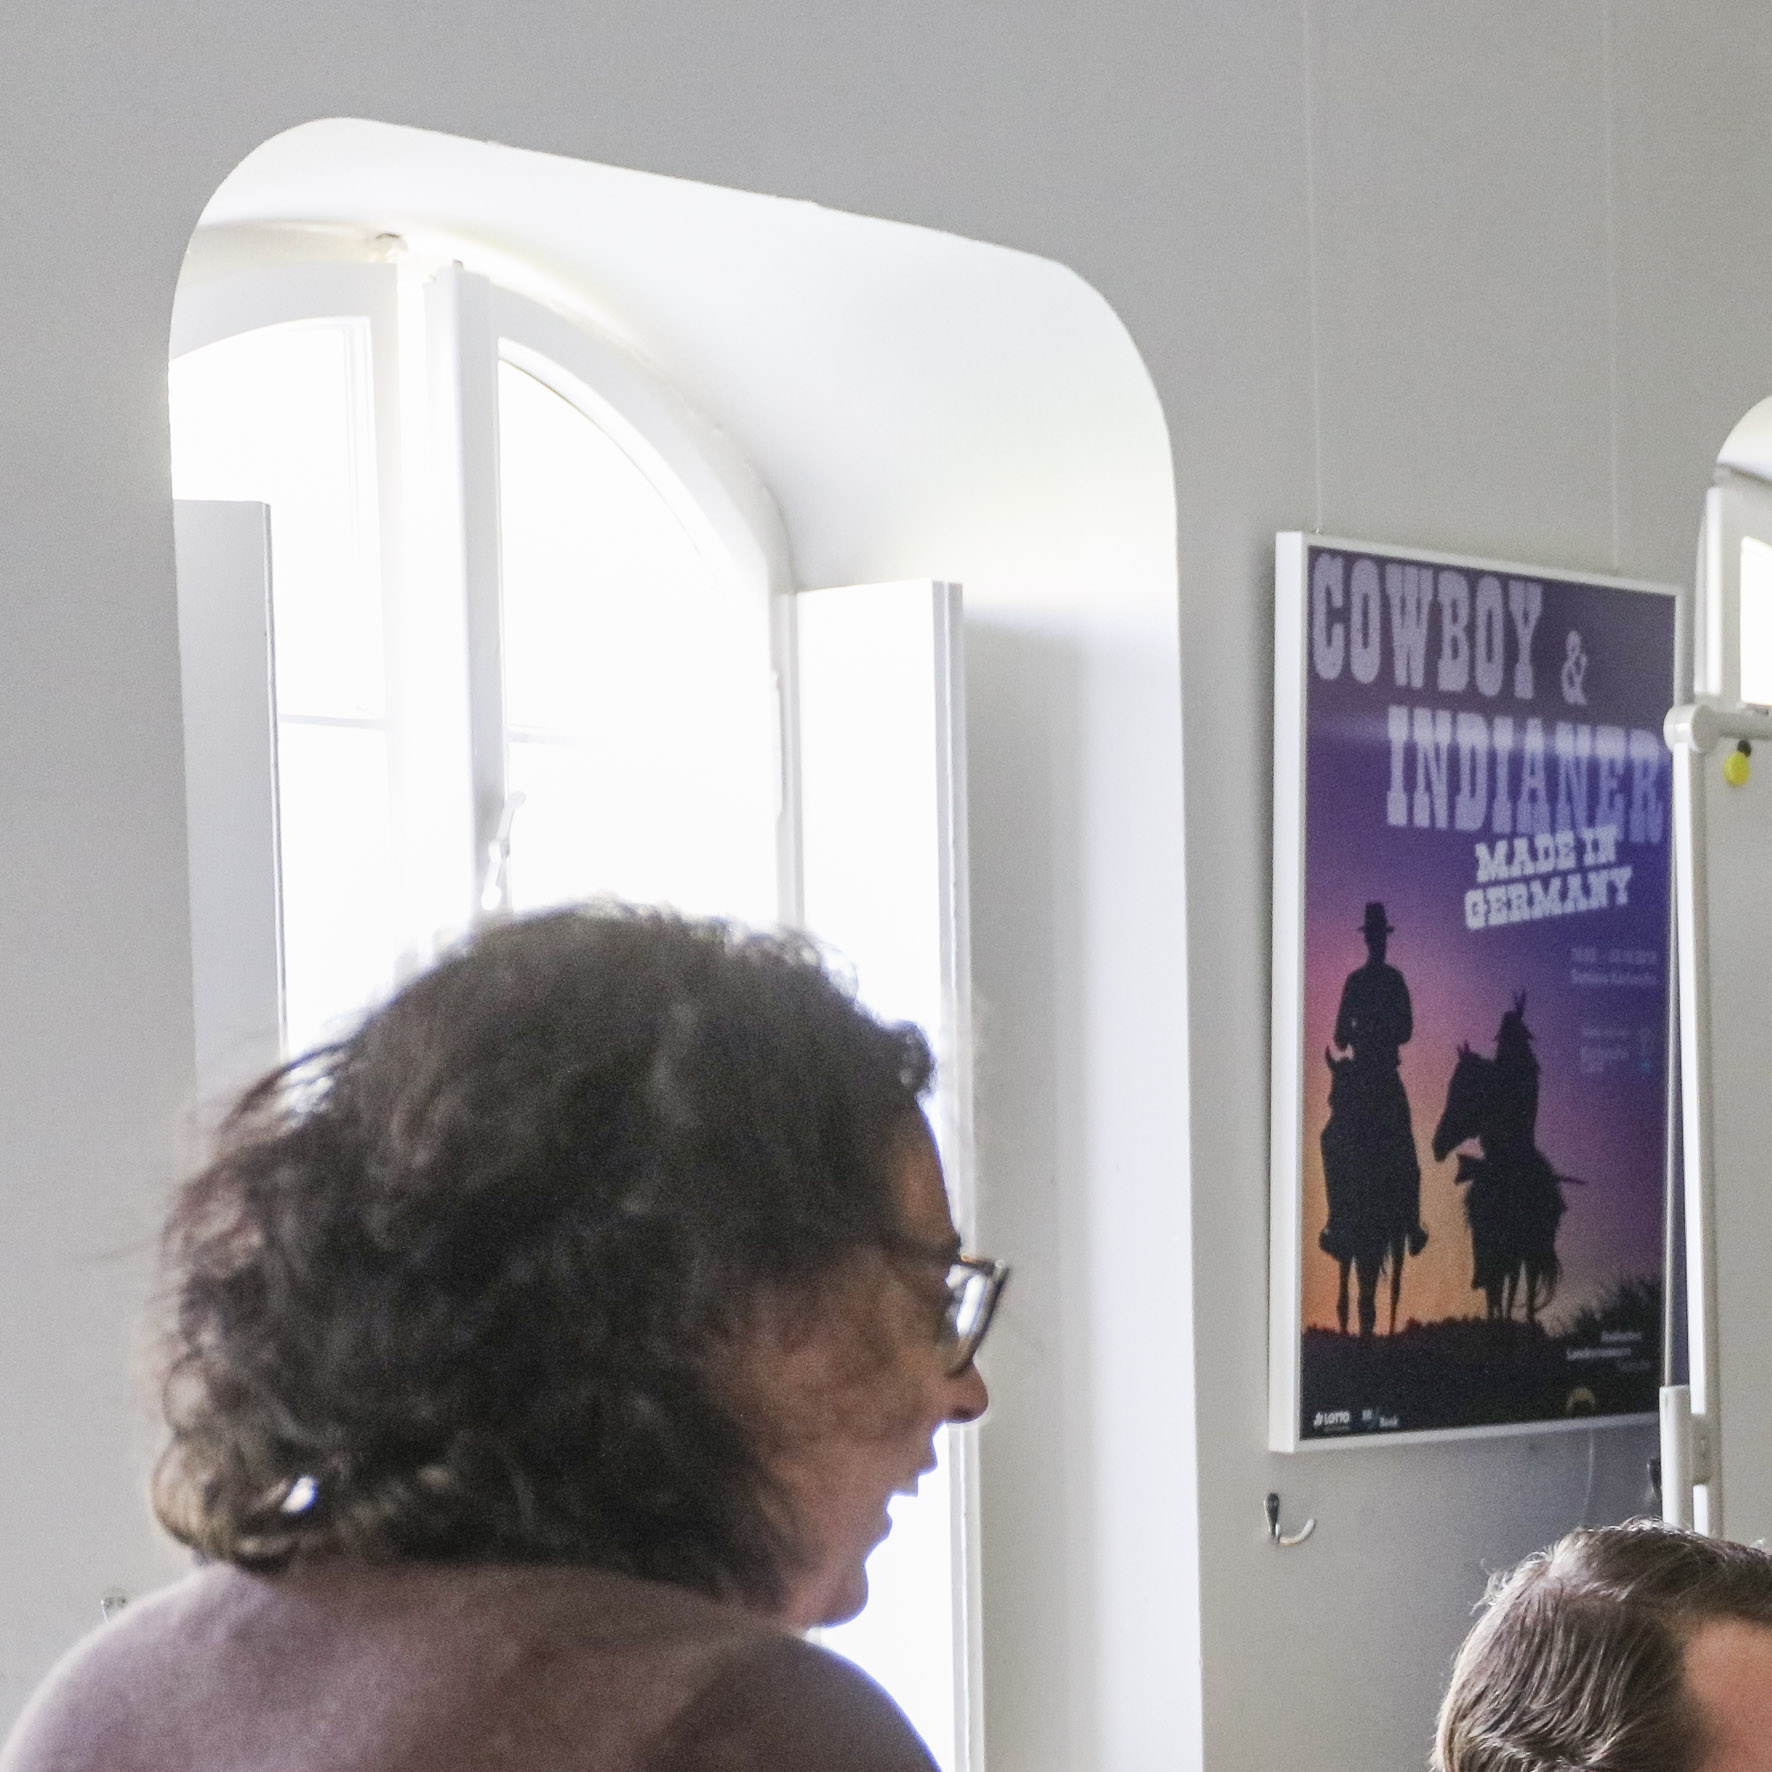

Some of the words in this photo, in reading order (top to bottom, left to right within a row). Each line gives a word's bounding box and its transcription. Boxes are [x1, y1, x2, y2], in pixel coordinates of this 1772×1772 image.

[1312, 553, 1543, 699] COWBOY
[1561, 631, 1588, 704] &
[1388, 705, 1662, 843] INDIANER
[1464, 867, 1632, 930] GERMANY
[1475, 831, 1576, 882] MADE
[1581, 825, 1618, 865] IN
